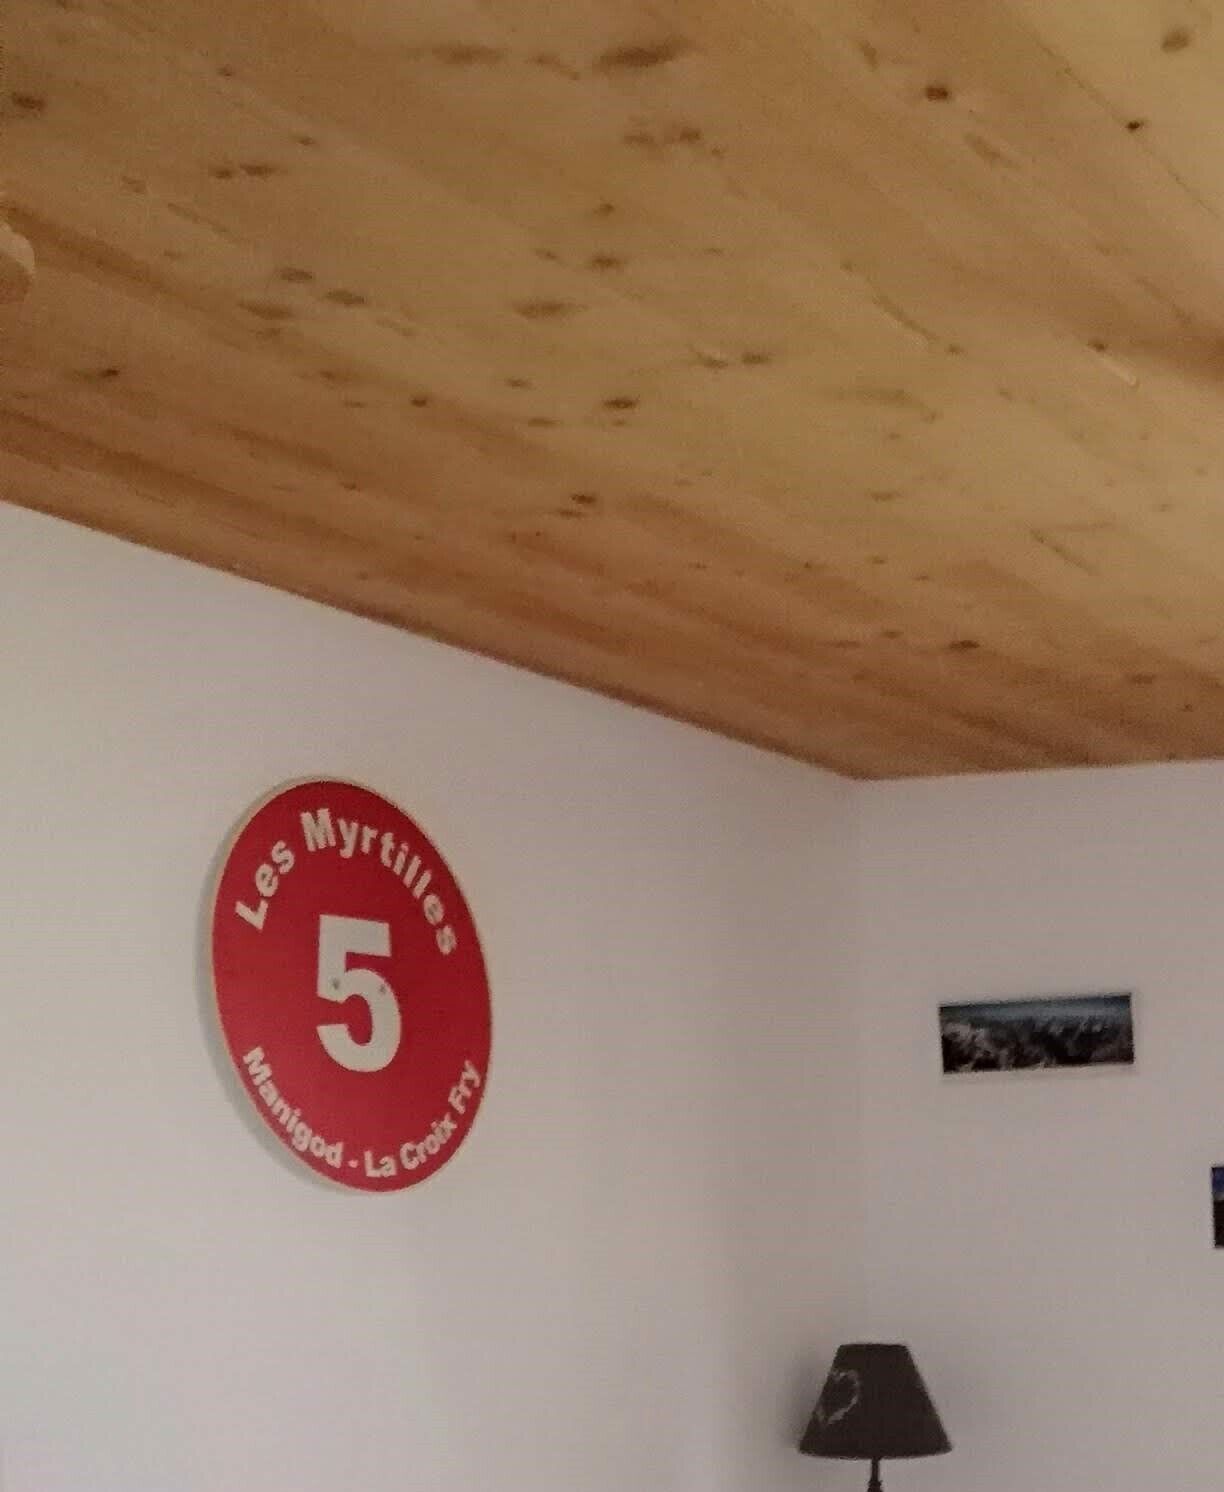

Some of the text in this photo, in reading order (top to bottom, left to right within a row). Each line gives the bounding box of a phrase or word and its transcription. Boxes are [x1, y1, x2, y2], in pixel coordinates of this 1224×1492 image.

[235, 808, 458, 955] Les Myrtilles
[317, 914, 401, 1072] 5
[242, 1047, 344, 1168] Manigod
[364, 1151, 397, 1178] La
[400, 1113, 457, 1170] Croix
[448, 1060, 481, 1115] Fry
